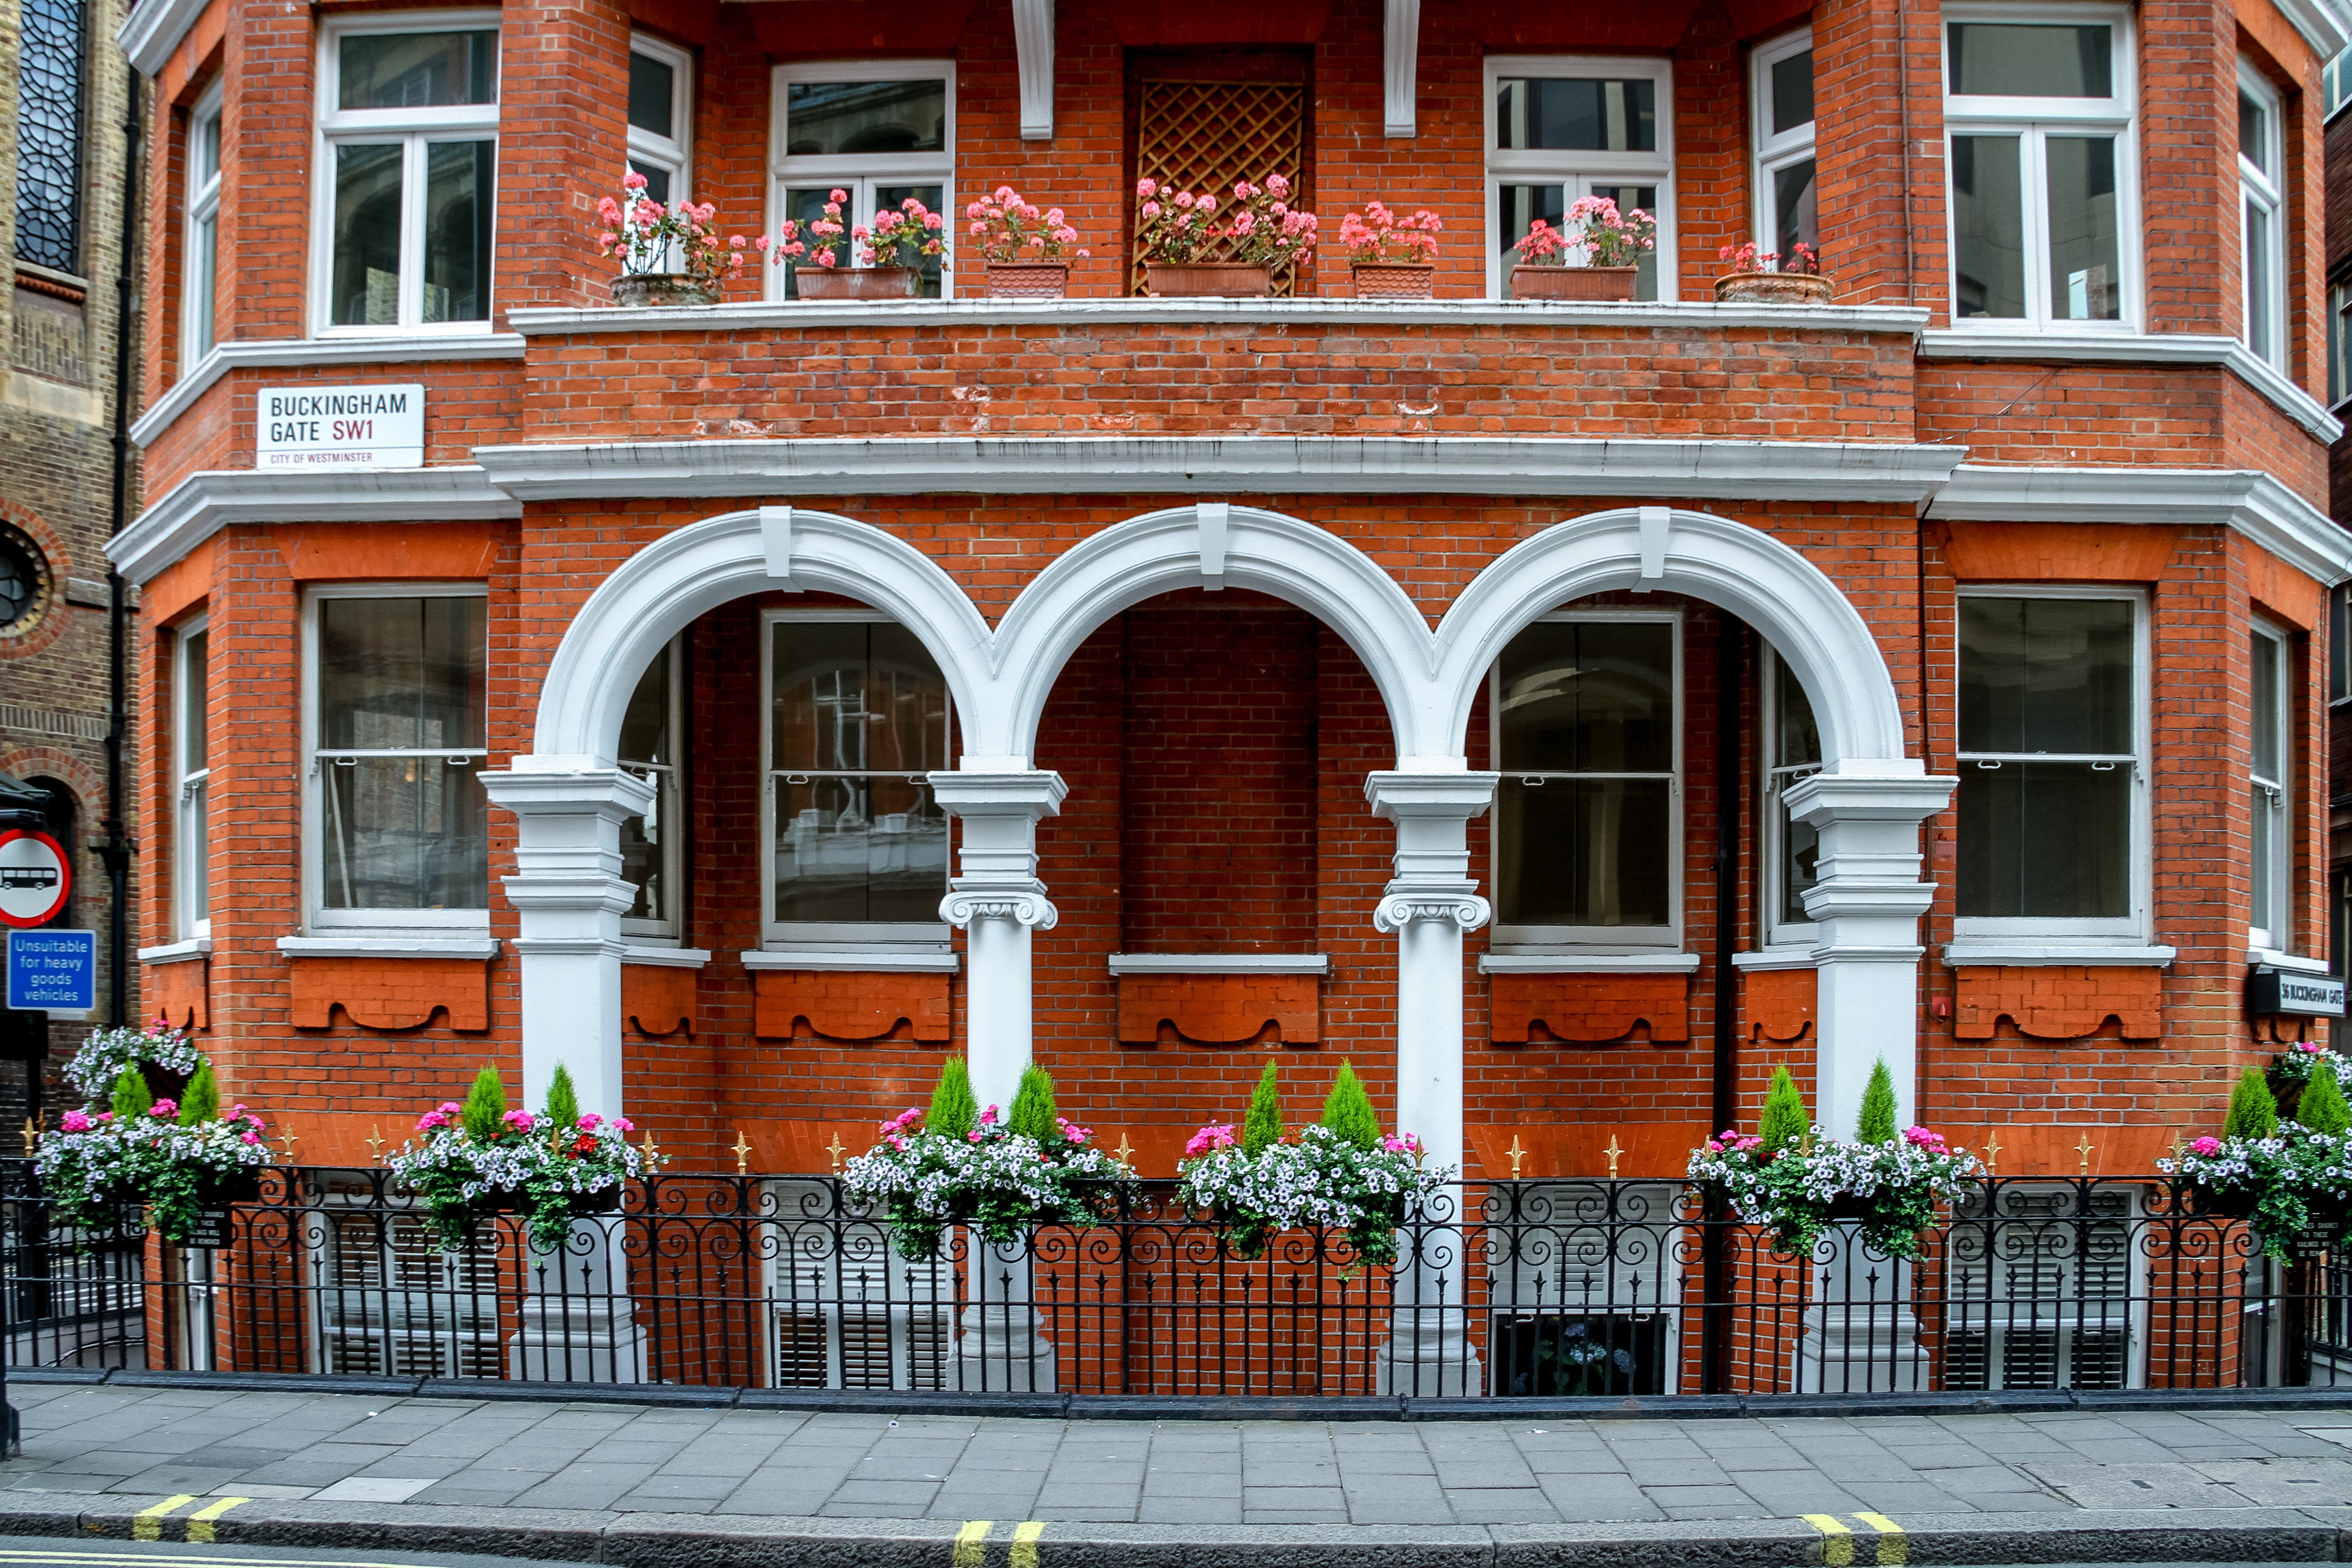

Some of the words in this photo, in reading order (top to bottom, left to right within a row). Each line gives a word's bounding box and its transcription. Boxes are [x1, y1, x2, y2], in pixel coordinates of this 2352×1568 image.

[271, 393, 407, 416] BUCKINGHAM
[271, 421, 320, 442] GATE
[333, 420, 373, 440] SW1
[270, 454, 290, 464] CITY
[294, 454, 304, 463] OF
[308, 453, 372, 463] WESTMINSTER
[15, 939, 88, 952] Unsuitable
[20, 956, 40, 968] for
[44, 956, 83, 971] heavy
[30, 972, 72, 987] goods
[24, 988, 79, 1001] vehicles
[2290, 984, 2328, 1003] BUCKINGHAM
[2329, 989, 2343, 1005] GATE
